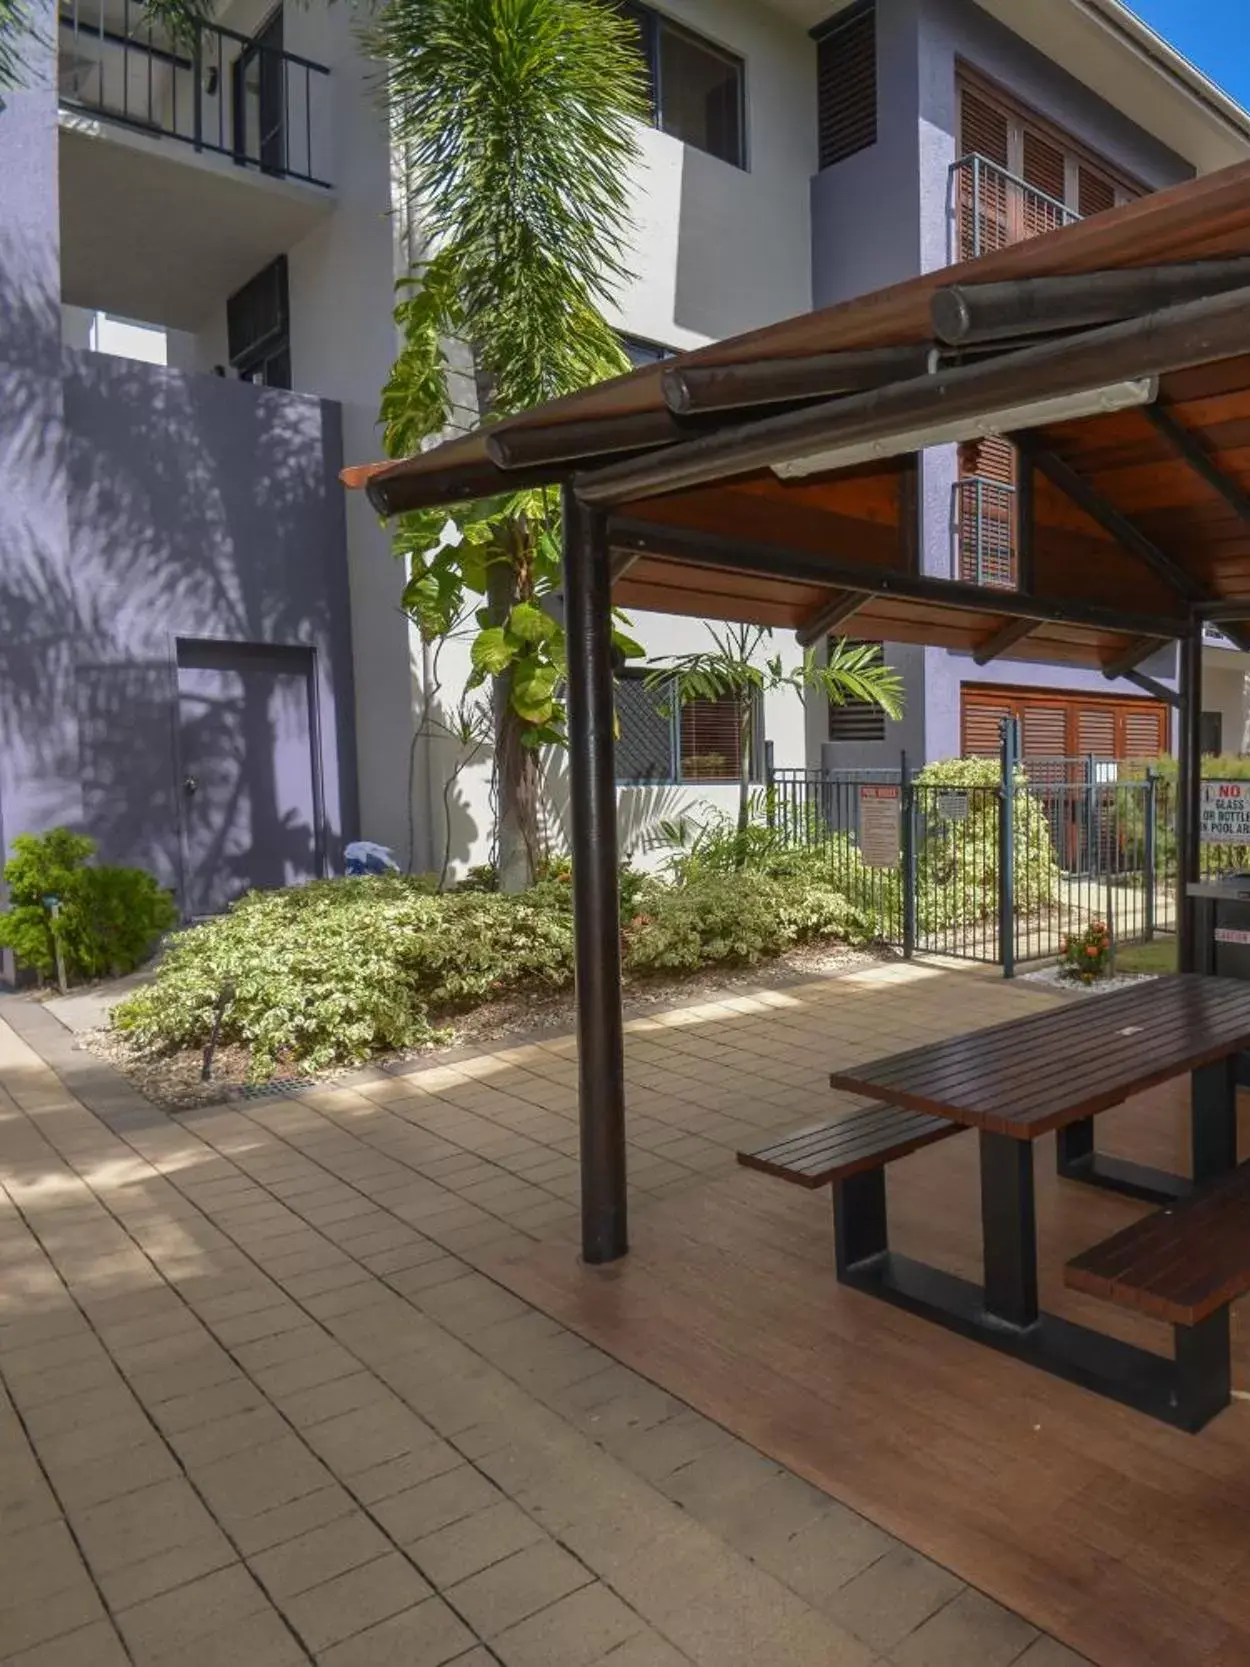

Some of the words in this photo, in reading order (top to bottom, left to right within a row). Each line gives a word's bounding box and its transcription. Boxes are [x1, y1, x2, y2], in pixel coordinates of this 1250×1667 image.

[1219, 784, 1241, 797] NO
[1215, 800, 1245, 810] GLASS
[1203, 811, 1215, 820] OR
[1211, 823, 1233, 833] POOL
